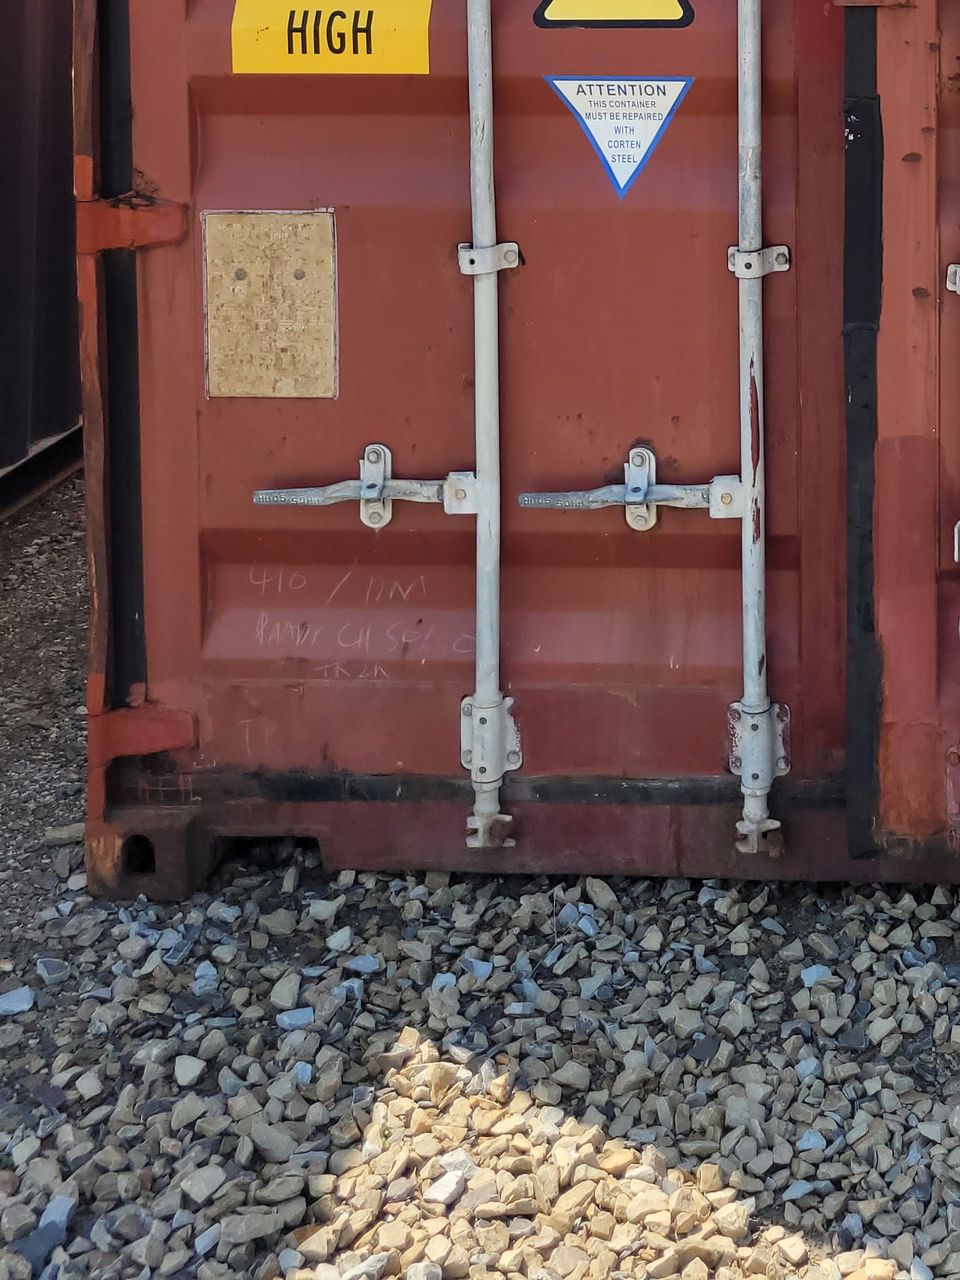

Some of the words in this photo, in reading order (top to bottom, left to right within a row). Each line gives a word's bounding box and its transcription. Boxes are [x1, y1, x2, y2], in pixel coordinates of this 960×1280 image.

[287, 10, 374, 55] HIGH
[576, 84, 667, 97] ATTENTION
[588, 100, 608, 108] THIS
[608, 100, 657, 109] CONTAINER
[585, 112, 608, 121] MUST
[609, 112, 621, 121] BE
[622, 112, 664, 121] REPAIRED
[613, 126, 635, 135] WITH
[607, 140, 642, 149] CORTEN
[611, 154, 638, 163] STEEL
